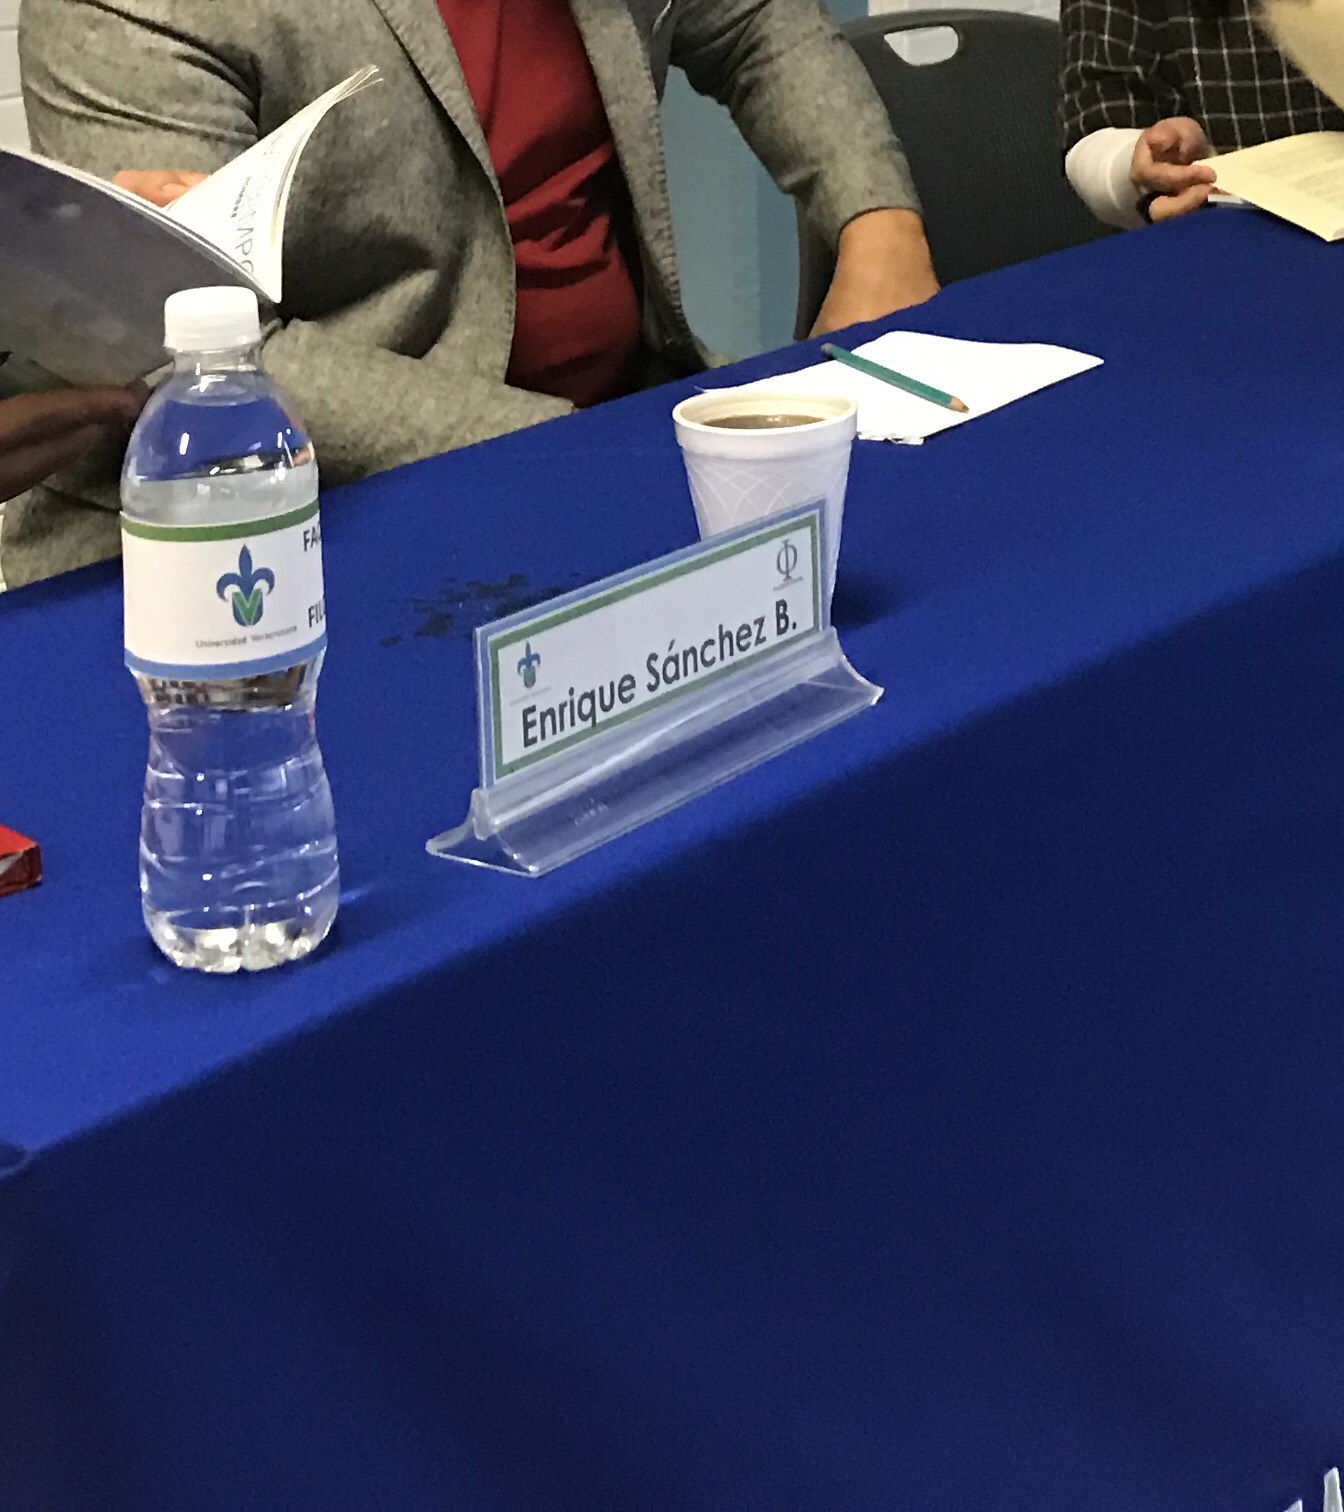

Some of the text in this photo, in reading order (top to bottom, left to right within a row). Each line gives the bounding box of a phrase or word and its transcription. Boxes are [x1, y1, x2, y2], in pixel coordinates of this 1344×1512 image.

[522, 598, 797, 748] Enrique Sánchez B.
